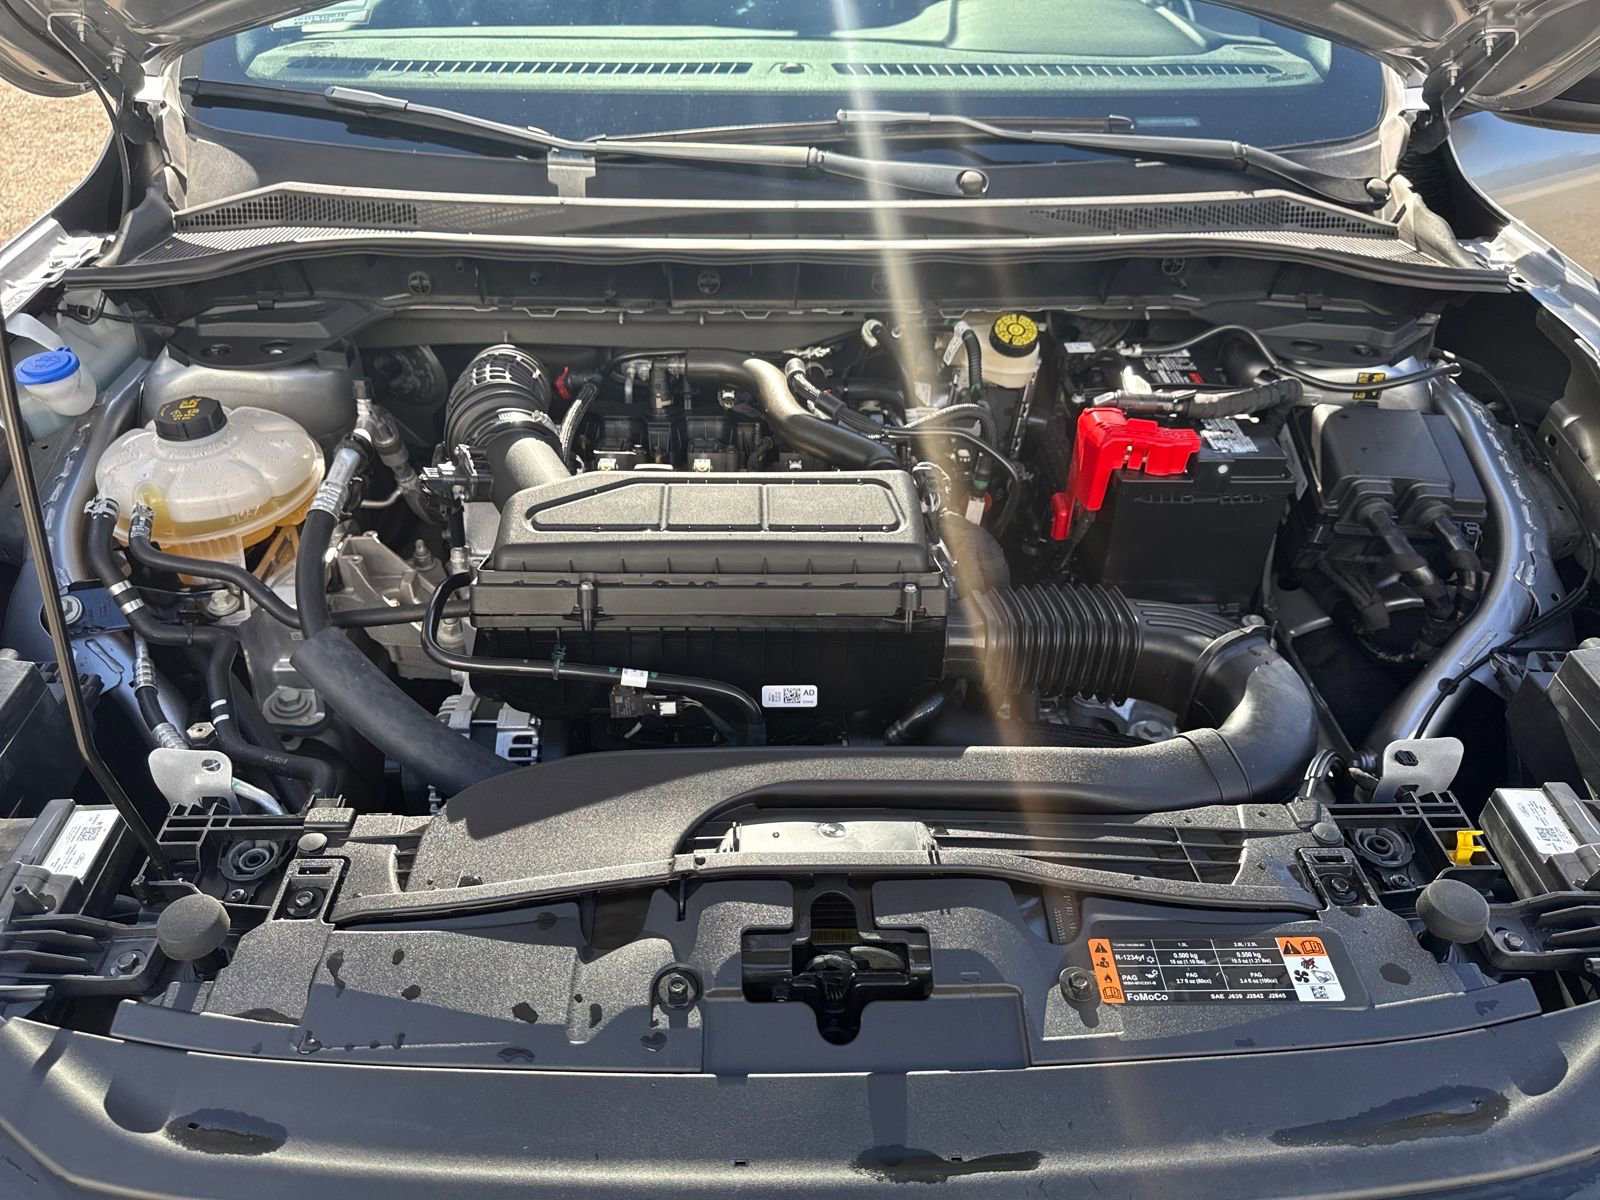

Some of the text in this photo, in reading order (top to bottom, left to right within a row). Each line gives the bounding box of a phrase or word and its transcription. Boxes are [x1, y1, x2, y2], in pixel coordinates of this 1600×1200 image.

[803, 689, 815, 697] AD
[1115, 954, 1145, 962] R-1234yf
[1190, 952, 1199, 960] kg
[1252, 951, 1261, 959] kg
[1127, 993, 1168, 1001] FoMoCo
